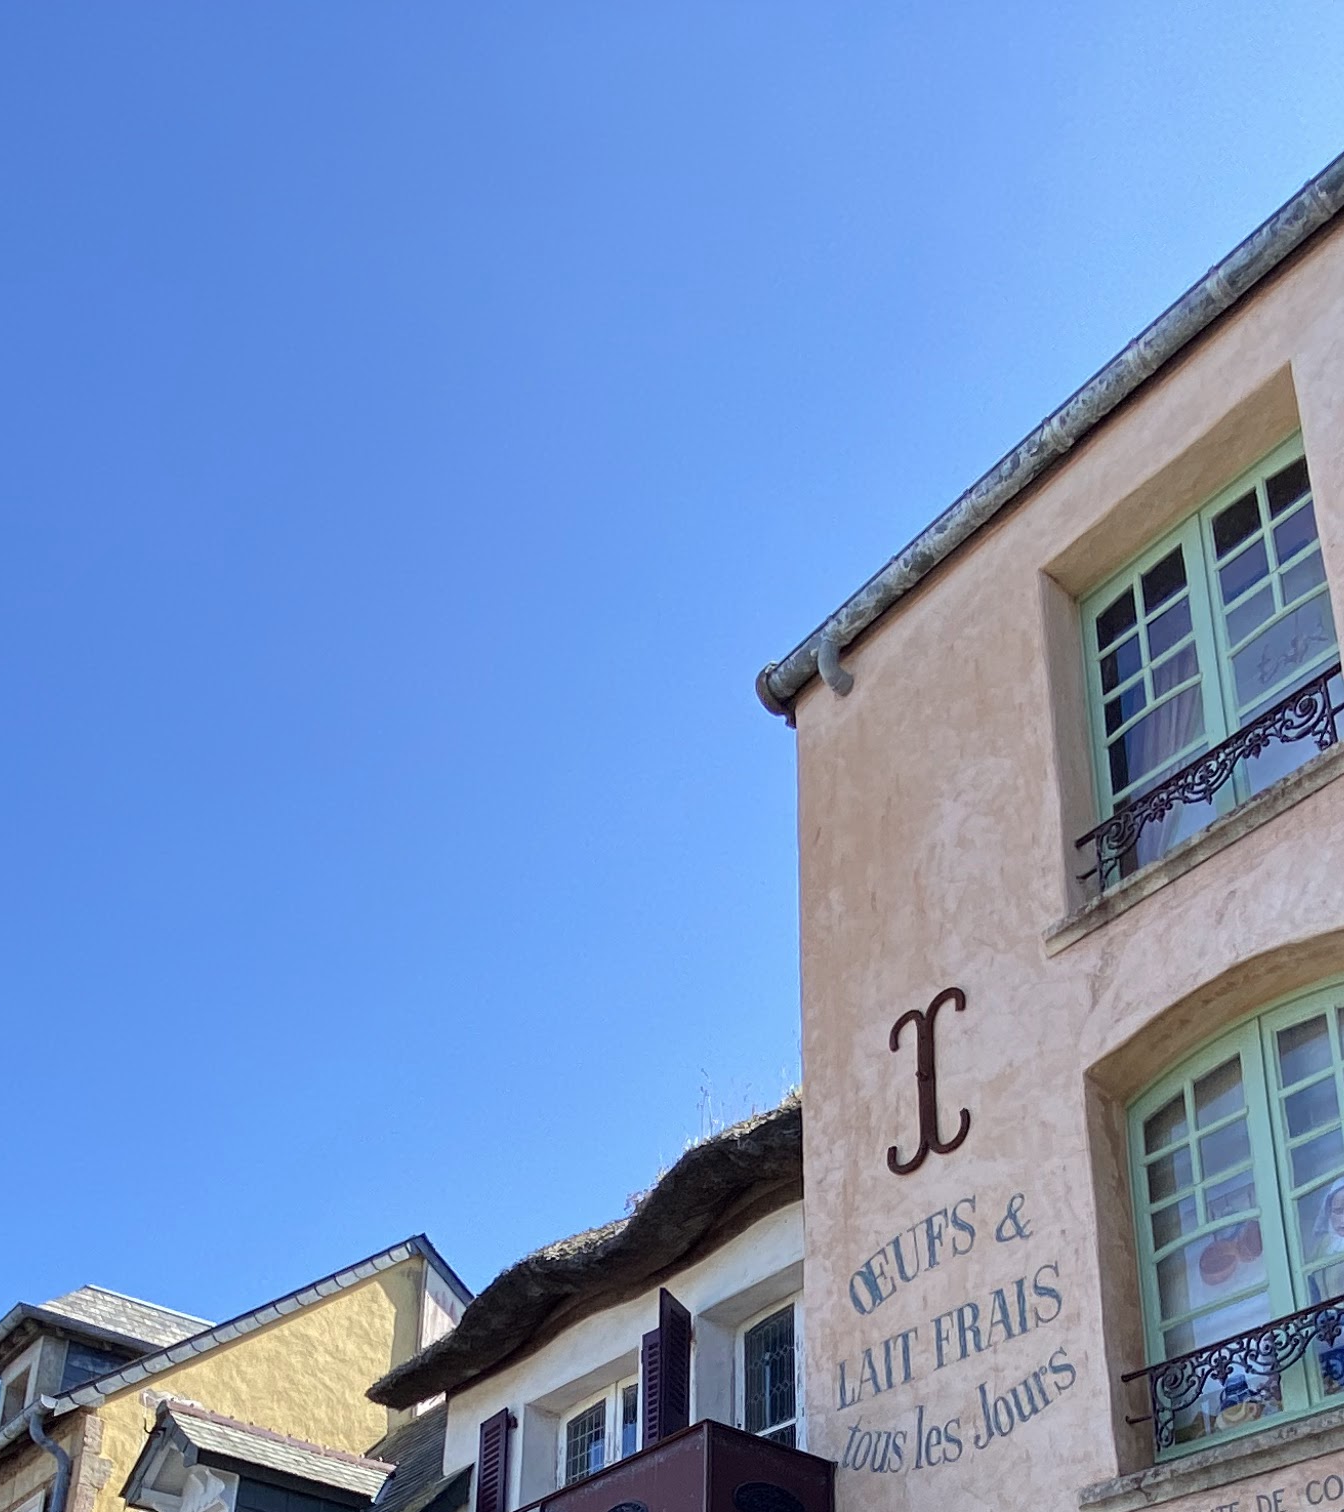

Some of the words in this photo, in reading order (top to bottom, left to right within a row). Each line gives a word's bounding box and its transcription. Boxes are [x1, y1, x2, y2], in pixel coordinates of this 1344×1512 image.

[849, 1195, 977, 1316] ŒUFS
[995, 1192, 1033, 1243] &
[836, 1327, 918, 1412] LAIT
[929, 1261, 1064, 1371] FRAIS
[840, 1413, 906, 1474] tous
[912, 1404, 965, 1471] les
[973, 1346, 1077, 1451] Jours
